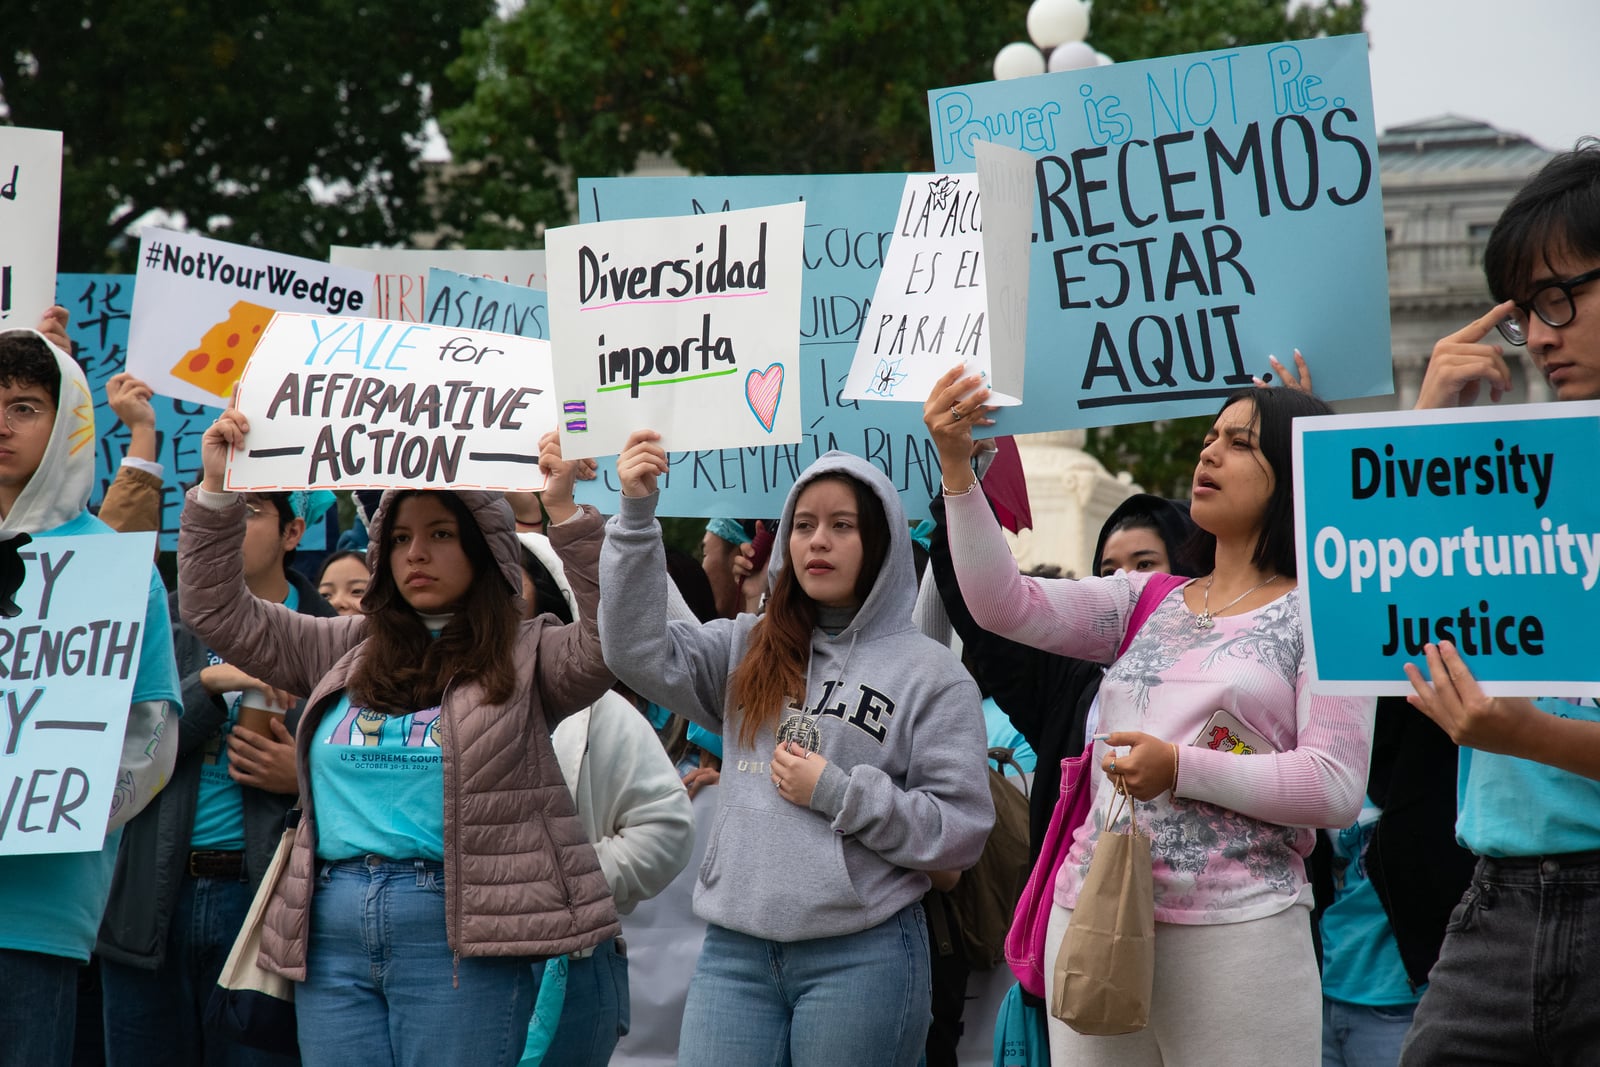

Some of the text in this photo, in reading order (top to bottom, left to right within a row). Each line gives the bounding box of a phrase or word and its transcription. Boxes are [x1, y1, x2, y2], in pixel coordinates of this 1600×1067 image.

[936, 44, 1346, 164] Power is NOT Pie.
[1031, 107, 1372, 243] RECEMOS
[902, 190, 982, 239] LA ACC
[146, 240, 364, 315] #NotYourWedge
[579, 222, 767, 304] Diversidad
[905, 250, 980, 295] ES EL
[1053, 225, 1255, 310] ESTAR
[304, 320, 504, 370] YALE for
[428, 286, 545, 339] ASIANS
[874, 312, 984, 356] PARA LA
[598, 313, 737, 398] importa
[1081, 305, 1273, 392] AQUI.
[266, 373, 543, 430] AFFIRMATIVE
[308, 424, 466, 484] ACTION
[1351, 438, 1554, 510] Diversity
[1314, 517, 1600, 593] Opportunity
[1382, 600, 1545, 657] Justice
[788, 680, 896, 746] LE
[340, 753, 359, 761] U.S.
[362, 754, 408, 763] SUPREME
